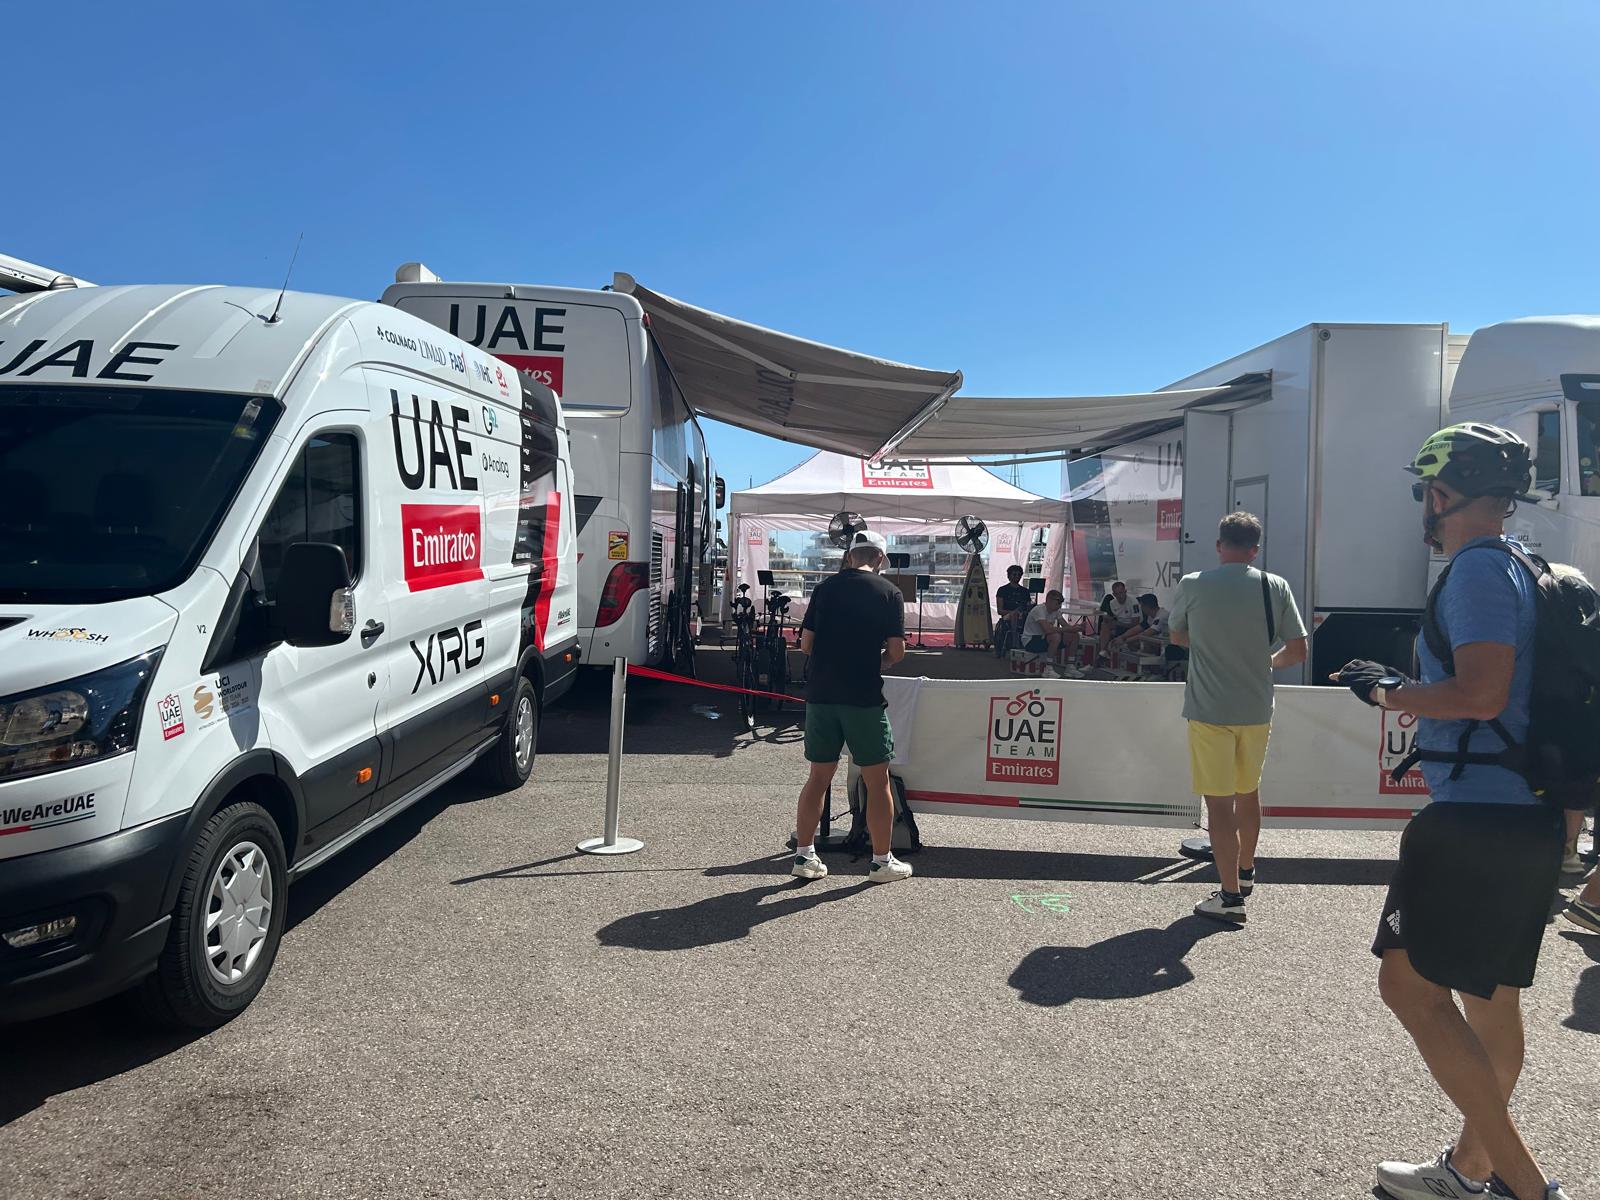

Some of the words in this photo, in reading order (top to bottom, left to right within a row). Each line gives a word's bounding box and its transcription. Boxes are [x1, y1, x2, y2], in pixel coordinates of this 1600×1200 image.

[450, 303, 567, 352] UAE
[385, 330, 417, 352] COLNAGO
[390, 388, 478, 491] UAE
[489, 454, 510, 478] Analog
[1158, 440, 1183, 491] UA
[867, 479, 928, 487] Emirates
[411, 526, 476, 568] Emirates
[1155, 561, 1181, 588] XR
[409, 619, 485, 695] XRG
[215, 676, 230, 689] UCI
[161, 705, 181, 721] UAE
[994, 718, 1056, 743] UAE
[993, 743, 1054, 758] TEAM
[992, 762, 1054, 778] Emirates
[0, 793, 95, 825] WeAreUAE
